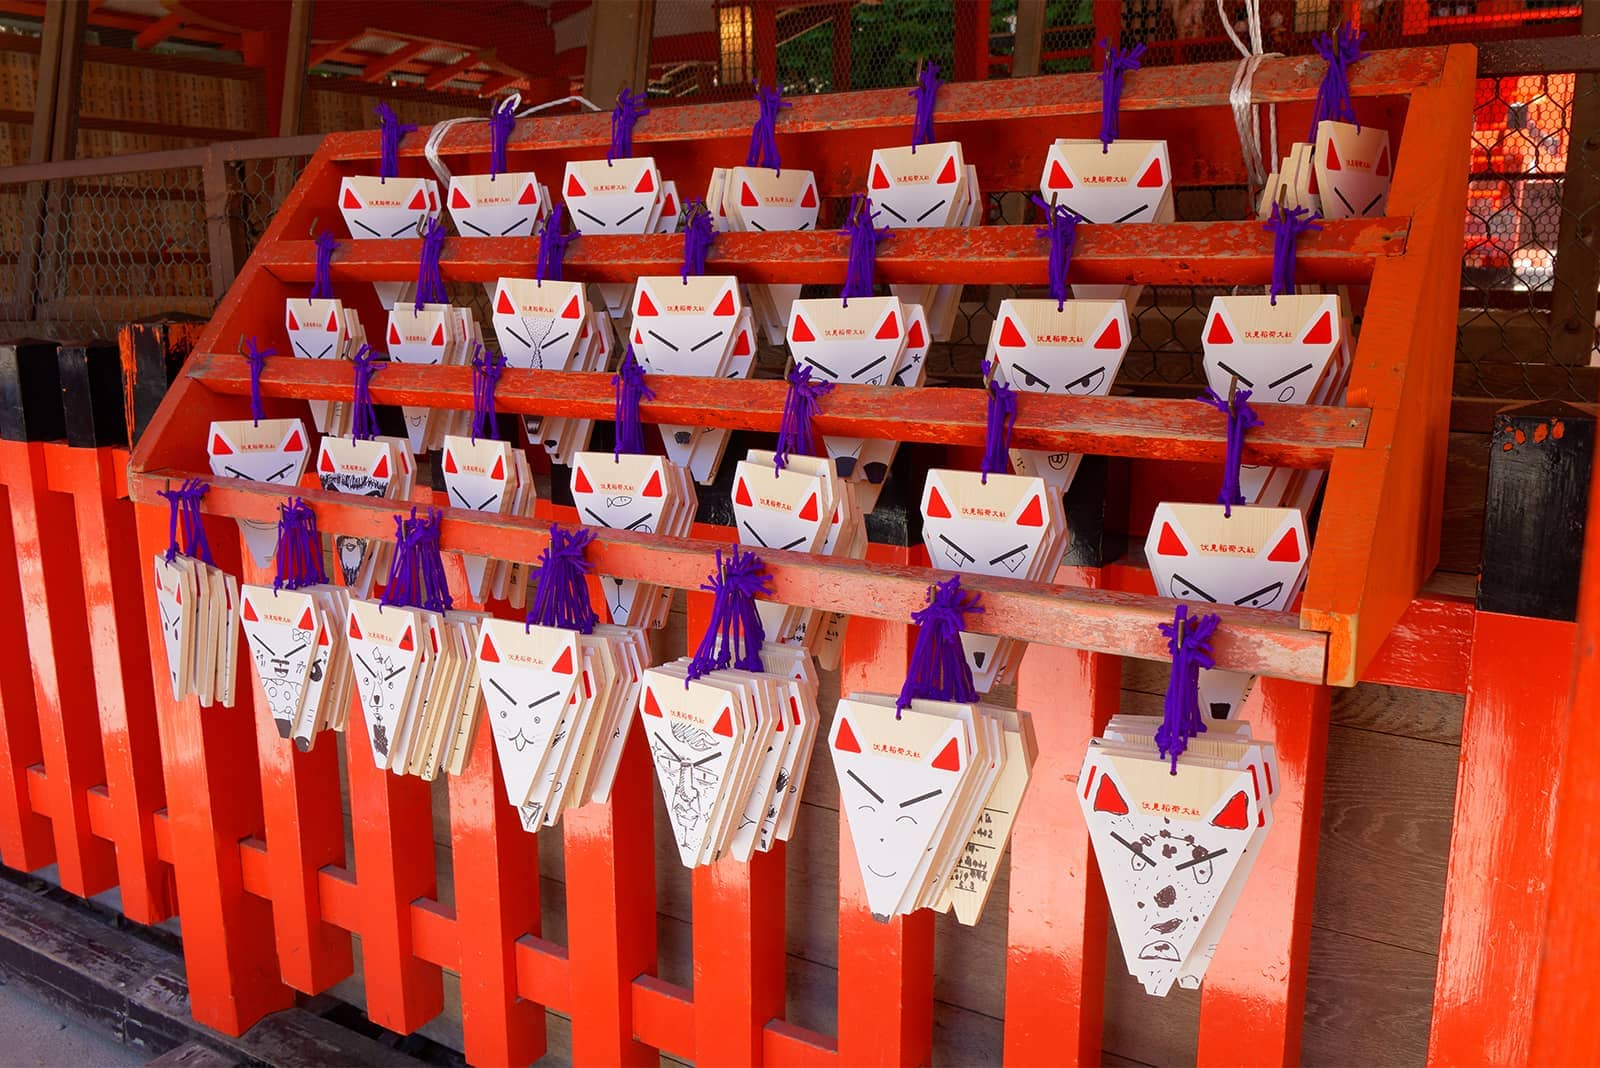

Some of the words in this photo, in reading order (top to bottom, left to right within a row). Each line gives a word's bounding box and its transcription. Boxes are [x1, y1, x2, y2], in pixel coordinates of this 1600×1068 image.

[897, 175, 929, 183] 伏見稲荷大社
[593, 184, 627, 192] 伏見稲荷大社
[522, 305, 554, 313] 伏見稲荷大社
[824, 329, 865, 337] 伏見稲荷大社
[1245, 331, 1292, 339] 伏見稲荷大社
[1037, 335, 1084, 343] 伏見稲荷大社
[600, 483, 634, 491] 伏見稲荷大社
[759, 498, 792, 511] 伏見稲荷大社
[962, 507, 1006, 518] 伏見稲荷大社
[1200, 544, 1256, 554] 伏見稲荷大社
[507, 654, 544, 665] 伏見稲荷大社
[670, 709, 705, 724] 伏見稲荷大社
[873, 743, 920, 758] 伏見稲荷大社
[1141, 801, 1200, 816] 伏見稲荷大社
